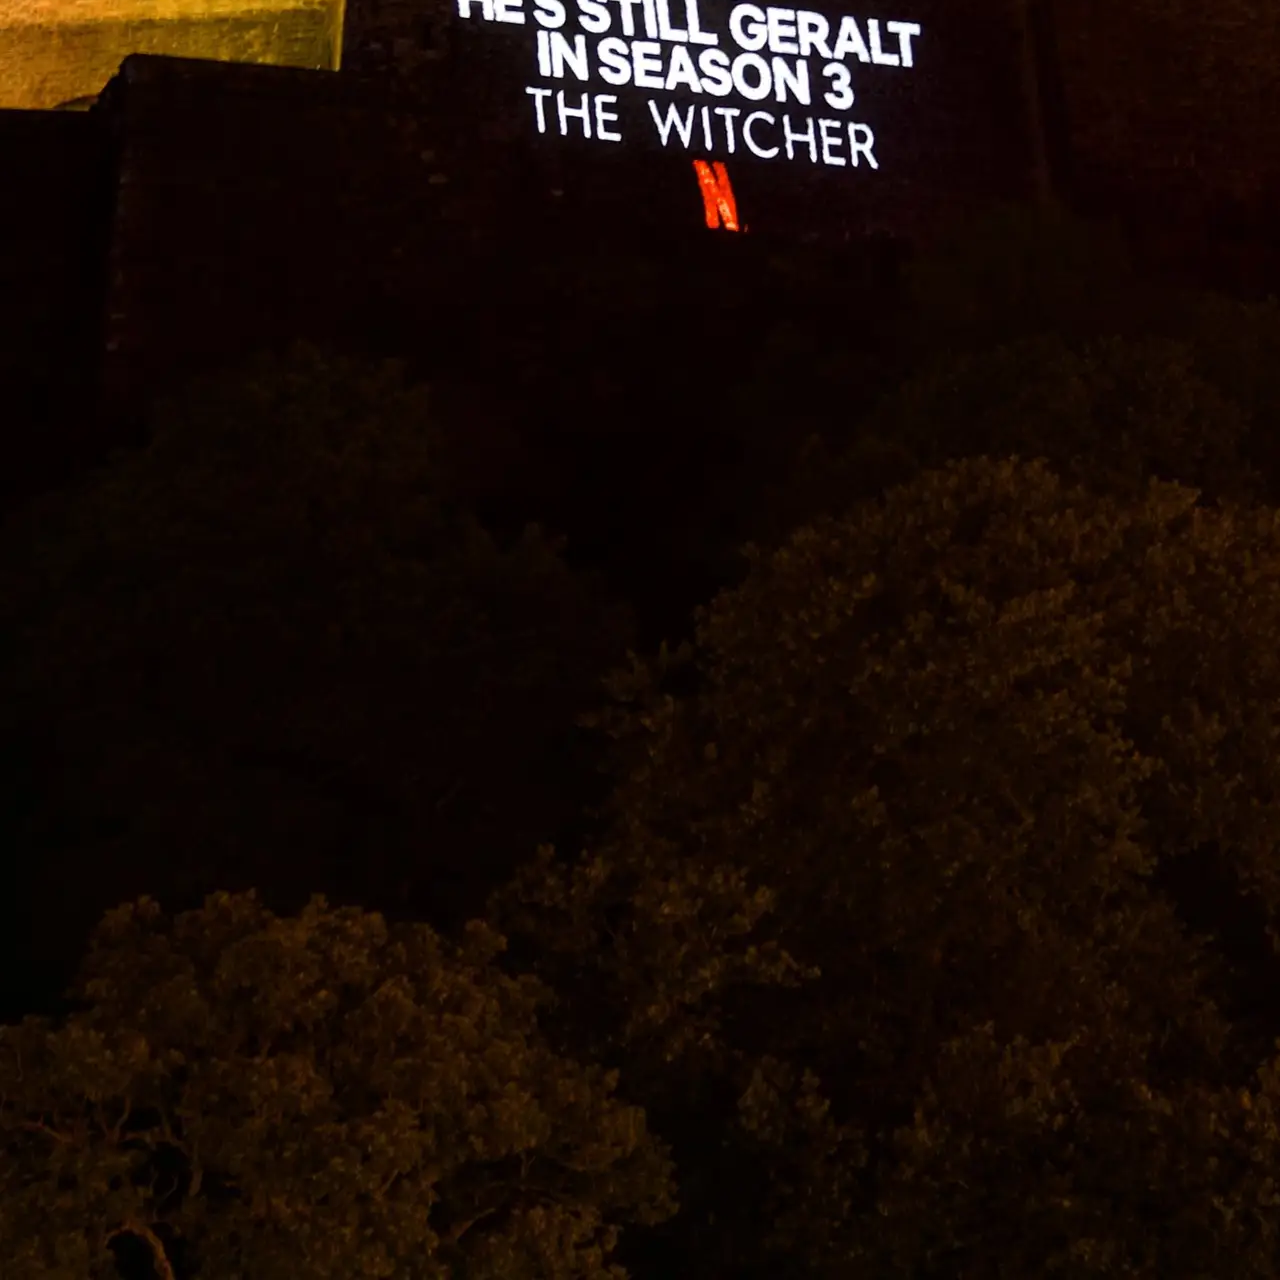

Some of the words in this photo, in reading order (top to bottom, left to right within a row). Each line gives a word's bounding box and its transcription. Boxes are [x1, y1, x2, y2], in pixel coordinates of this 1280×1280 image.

[536, 29, 590, 82] IN
[596, 36, 811, 106] SEASON
[822, 61, 855, 111] 3
[728, 3, 921, 68] GERALT
[525, 86, 622, 143] THE
[647, 98, 880, 171] WITCHER
